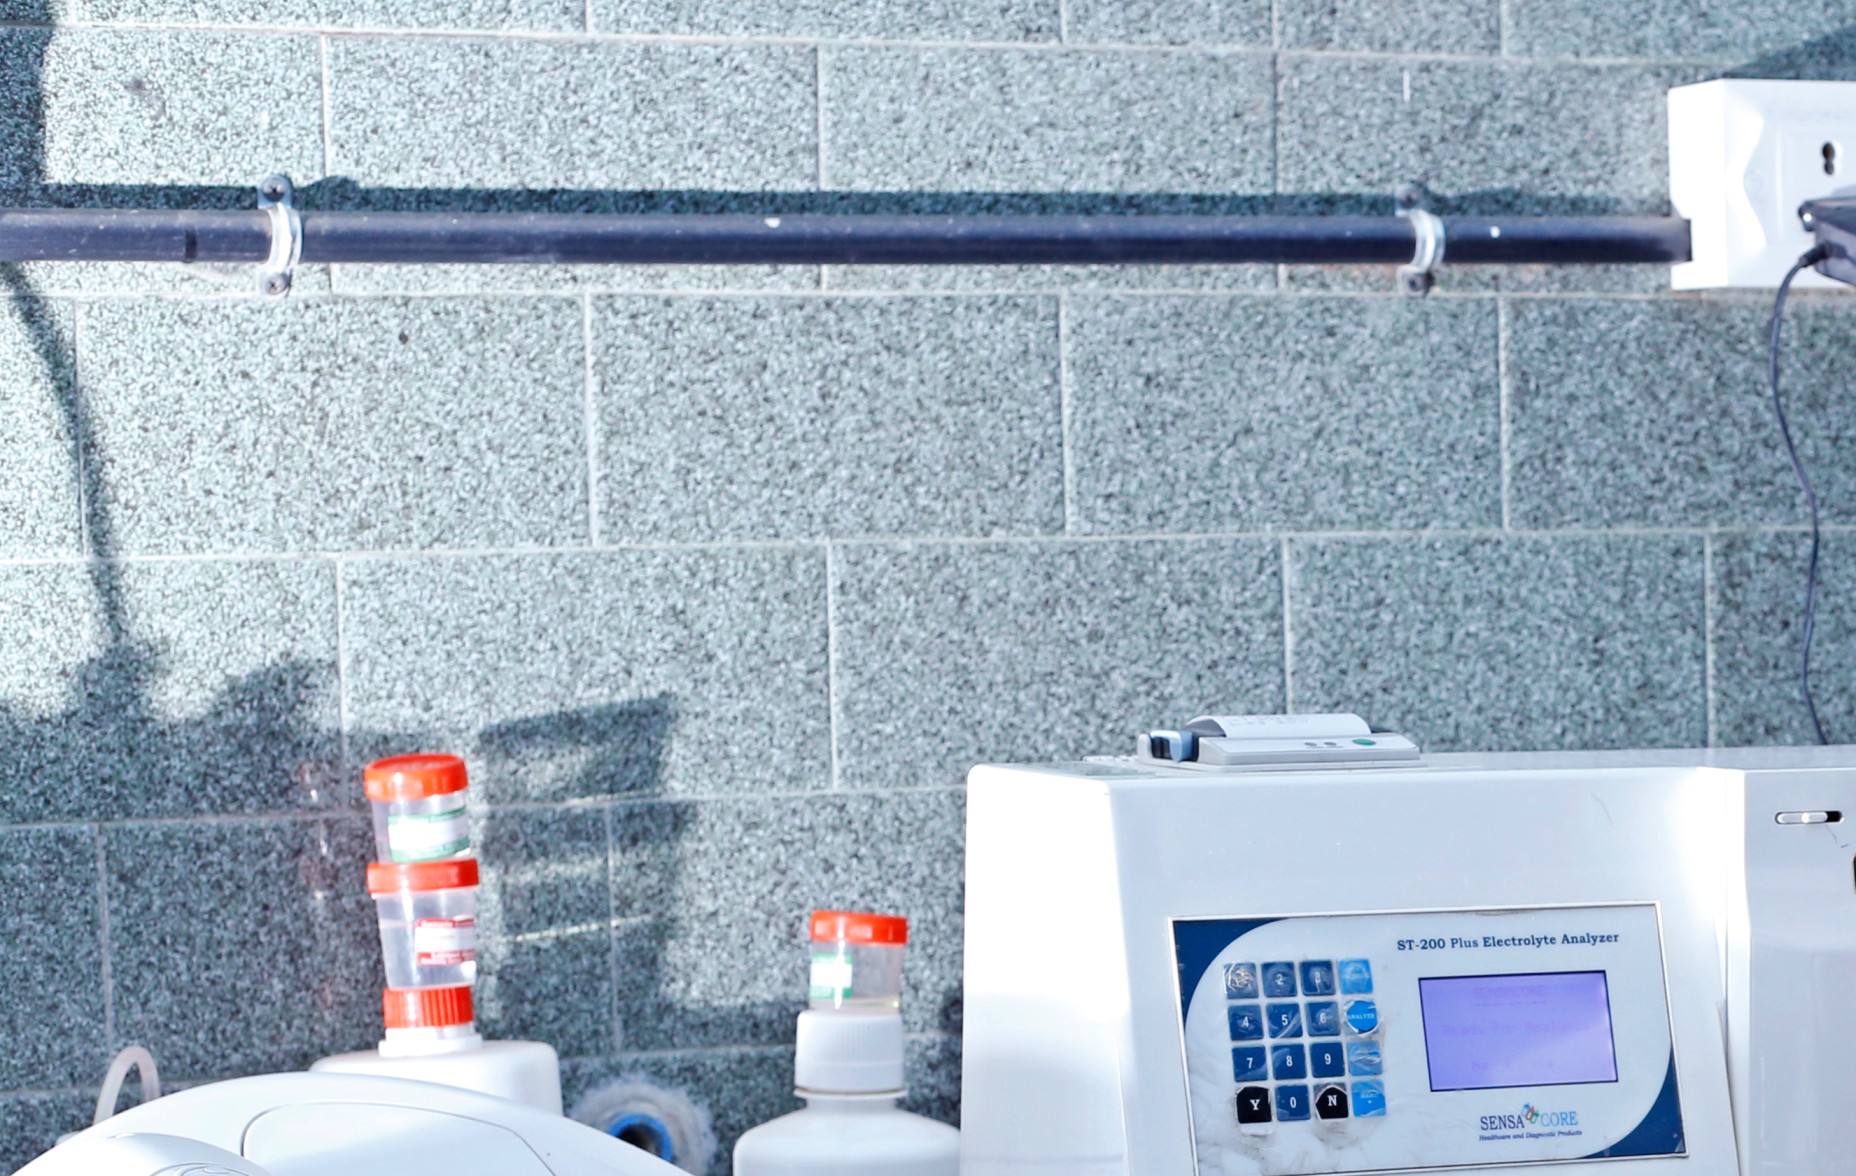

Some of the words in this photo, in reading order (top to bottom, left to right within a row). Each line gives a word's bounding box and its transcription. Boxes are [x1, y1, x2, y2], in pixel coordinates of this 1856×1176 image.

[1397, 938, 1446, 951] ST-200
[1450, 937, 1479, 949] Plus
[1483, 934, 1556, 948] Electrolyte
[1561, 932, 1619, 946] Analyzer
[1241, 1016, 1249, 1028] 4
[1281, 1014, 1289, 1026] 5
[1320, 1012, 1327, 1023] 6
[1246, 1057, 1253, 1069] 7
[1286, 1055, 1293, 1067] 8
[1324, 1053, 1331, 1065] 9
[1250, 1099, 1260, 1111] Y
[1327, 1095, 1338, 1106] N
[1480, 1114, 1525, 1131] SENSA
[1540, 1111, 1578, 1127] CORE
